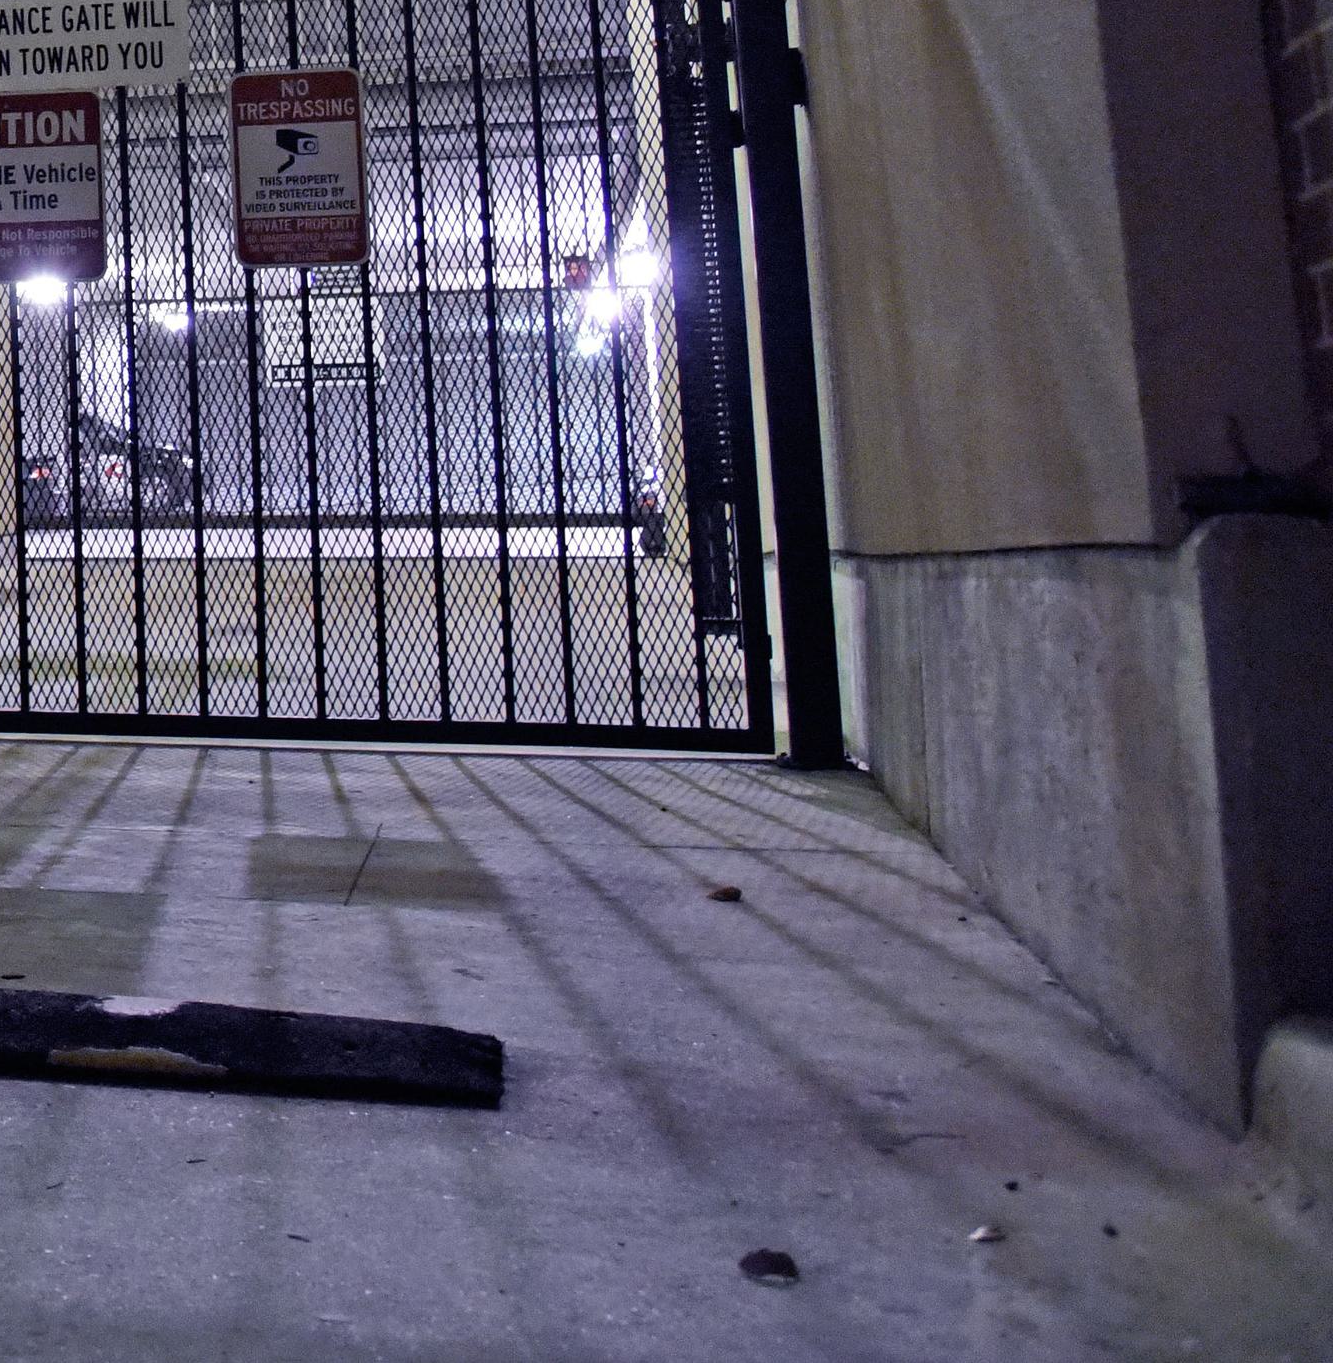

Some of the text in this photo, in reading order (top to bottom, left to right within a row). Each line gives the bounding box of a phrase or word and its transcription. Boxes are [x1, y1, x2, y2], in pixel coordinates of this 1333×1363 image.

[60, 2, 117, 33] GATE
[122, 0, 176, 30] WILL
[18, 43, 110, 76] TOWARD
[116, 40, 164, 70] YOU
[281, 78, 310, 98] NO
[237, 97, 356, 121] TRESPASSING
[22, 161, 97, 185] Vehicle
[259, 173, 341, 187] THIS PROPERTY
[9, 189, 60, 211] Time
[255, 186, 345, 200] IS PROTECTED BY
[244, 199, 357, 214] VIDEO SURVEILLANCE
[1, 228, 23, 241] Not
[26, 225, 100, 242] Responsible
[243, 216, 358, 233] PRIVATE PROPERTY
[17, 243, 32, 257] To
[34, 243, 78, 257] Vehicle
